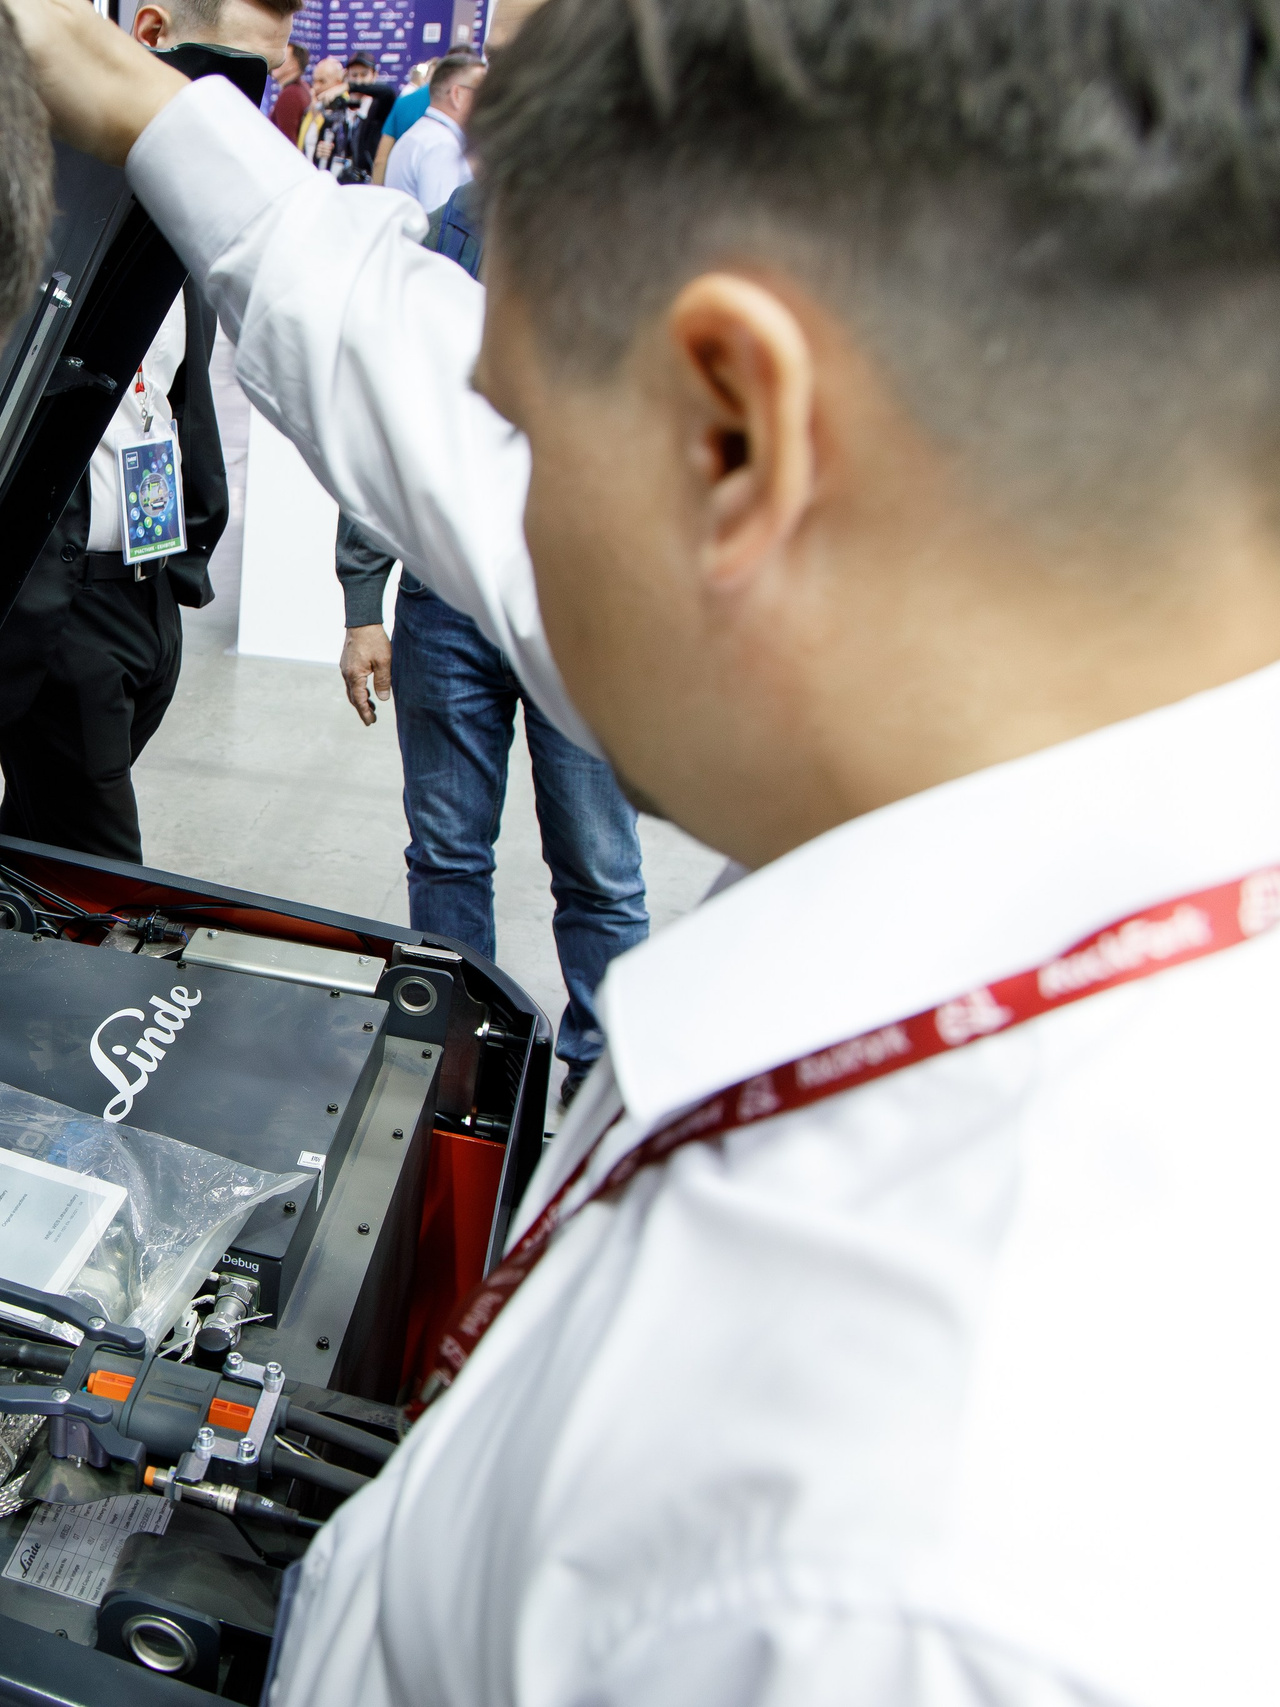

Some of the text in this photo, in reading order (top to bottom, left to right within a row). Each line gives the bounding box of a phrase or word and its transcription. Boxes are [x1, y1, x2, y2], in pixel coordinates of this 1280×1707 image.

[90, 985, 202, 1123] Linde
[222, 1253, 260, 1273] Debug
[20, 1542, 41, 1578] Linde
